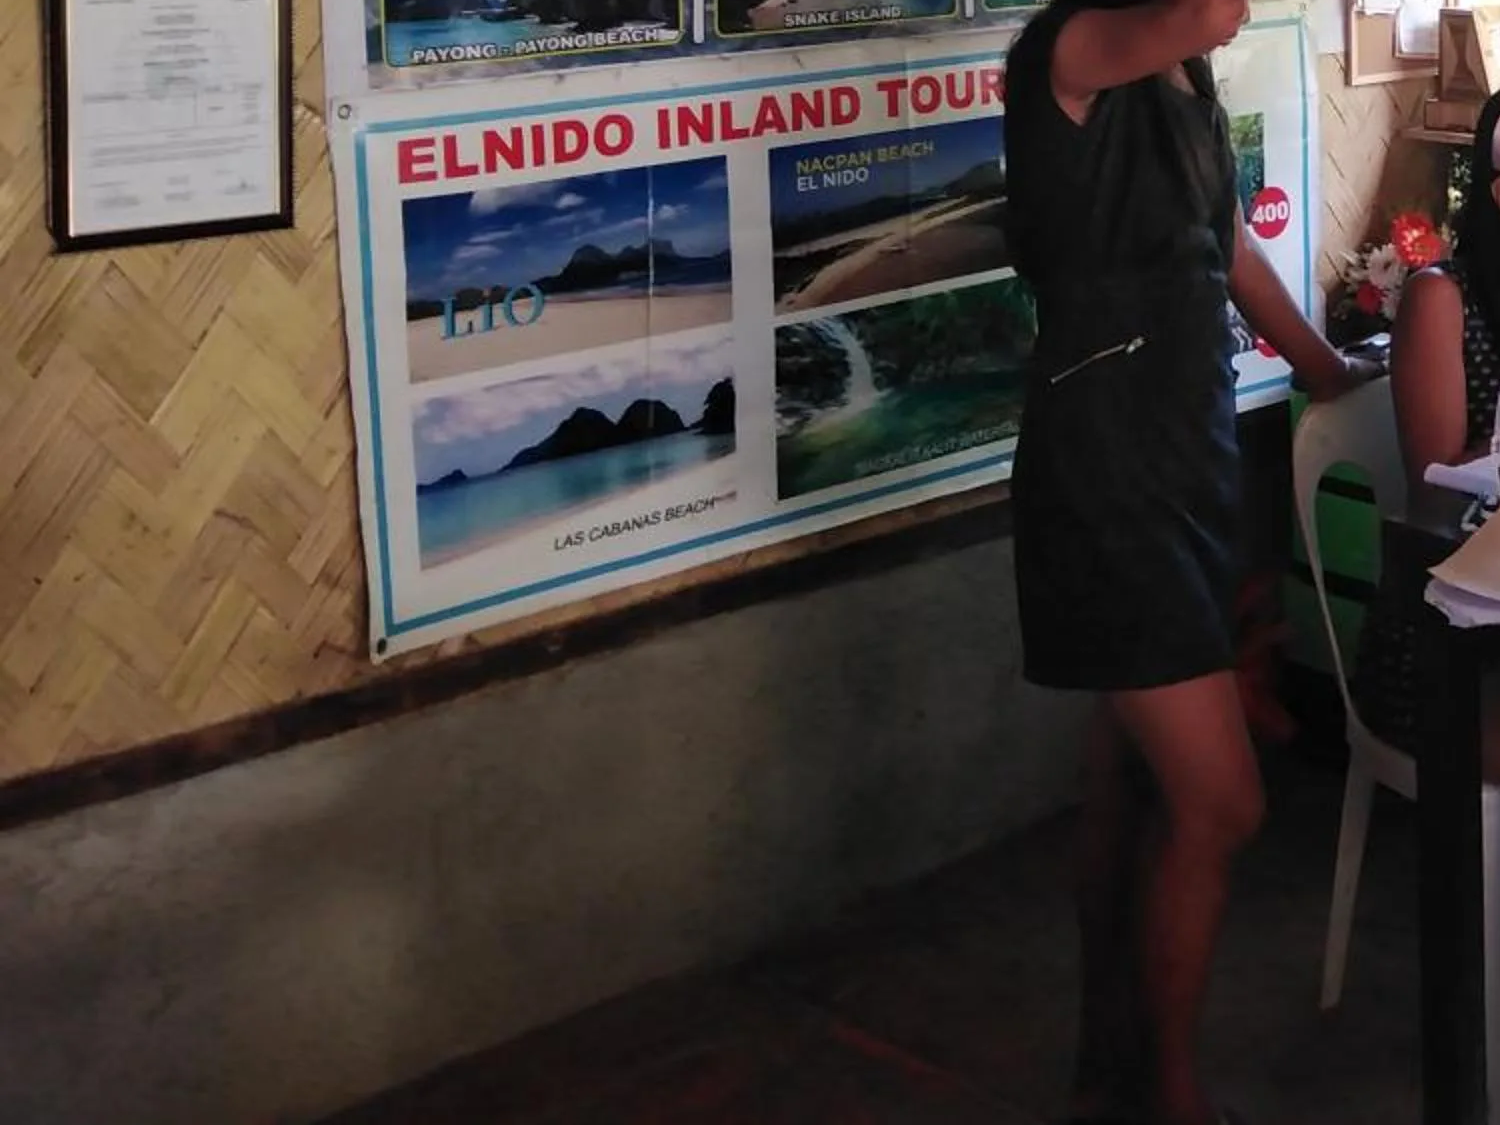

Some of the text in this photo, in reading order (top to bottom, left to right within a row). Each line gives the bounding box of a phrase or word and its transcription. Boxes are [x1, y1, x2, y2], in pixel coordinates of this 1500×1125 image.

[784, 5, 902, 28] SNAKE ISLAND
[412, 43, 497, 65] PAYONG
[515, 33, 588, 55] PAYONG
[594, 27, 658, 45] BEACH
[398, 114, 634, 185] ELNIDO
[657, 86, 861, 150] INLAND
[796, 139, 935, 175] NACPAN BEACH
[796, 166, 869, 192] EL NIDO
[1251, 200, 1289, 224] 400
[554, 495, 716, 552] LAS CABANAS BEACH
